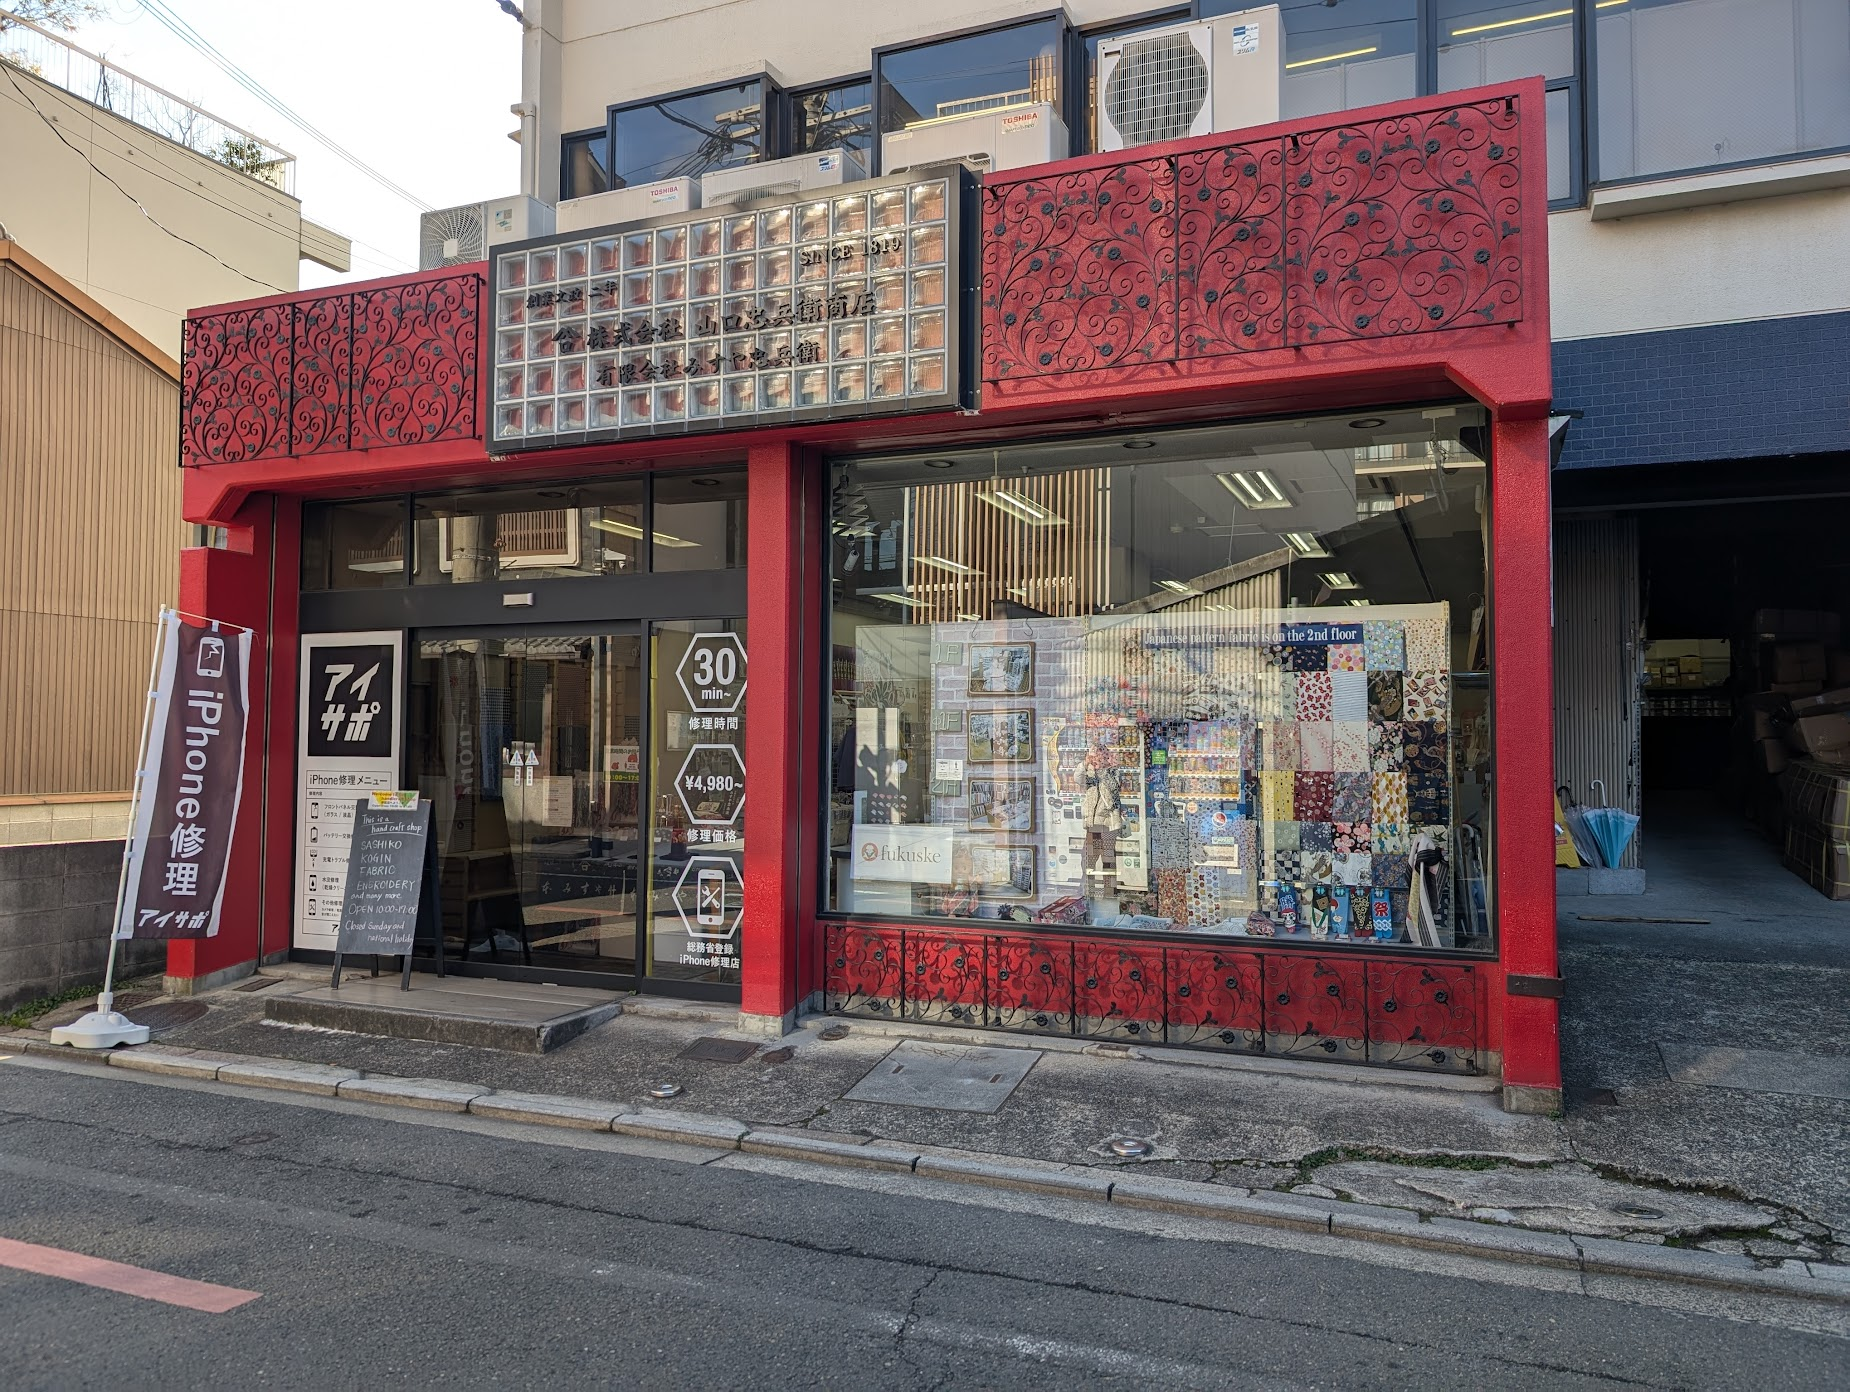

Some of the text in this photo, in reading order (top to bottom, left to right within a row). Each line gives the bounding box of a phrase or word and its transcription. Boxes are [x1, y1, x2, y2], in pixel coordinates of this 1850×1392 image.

[1002, 112, 1038, 125] TOSHIBA
[650, 185, 679, 197] TOSHIBA
[799, 236, 901, 266] SINCE 1819
[526, 287, 584, 309] 創業文政
[586, 289, 878, 350] 株式会社 山口忠兵衛商店
[1144, 627, 1357, 645] Japanese pattern fabric is on the 2nd floor
[693, 647, 737, 686] 30
[688, 716, 739, 731] 修理時間
[162, 689, 224, 897] iPhone修理
[362, 814, 375, 824] This
[371, 822, 423, 834] hand craft shop
[687, 828, 737, 843] 修理価格
[361, 839, 403, 851] SASHIKO
[360, 853, 392, 864] KOGIN
[880, 844, 942, 864] fukuske
[359, 865, 397, 876] FABRIC
[350, 891, 365, 901] and
[365, 893, 383, 902] many
[138, 908, 210, 930] アイサポ
[344, 919, 406, 933] Closed Sunday and
[331, 924, 340, 933] ア
[367, 932, 394, 943] national
[686, 941, 734, 955] 総務省登録
[679, 954, 740, 969] iPhone修理店
